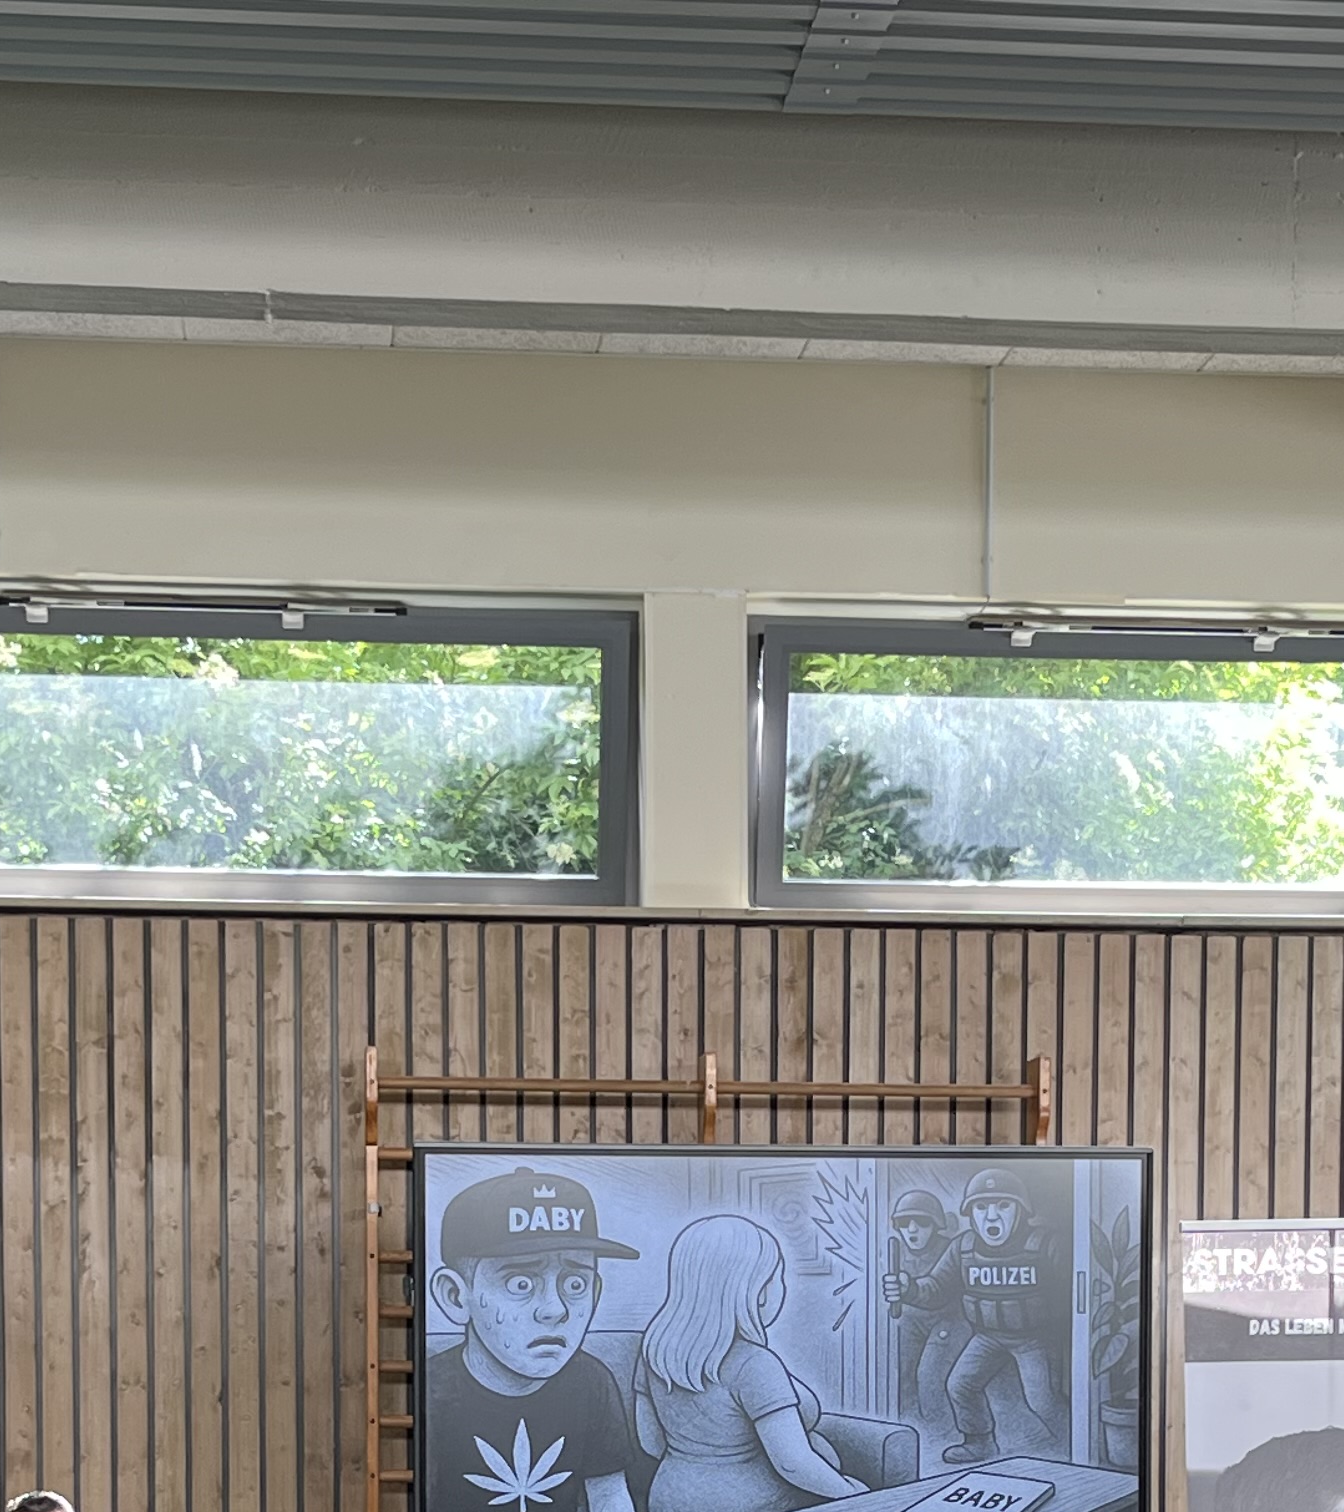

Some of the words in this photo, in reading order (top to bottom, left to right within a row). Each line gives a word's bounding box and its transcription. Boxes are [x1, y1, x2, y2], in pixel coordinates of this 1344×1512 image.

[509, 1206, 585, 1232] DABY
[969, 1266, 1037, 1285] POLIZEI
[1249, 1319, 1281, 1335] DAS
[1284, 1318, 1334, 1335] LEBEN
[942, 1487, 1022, 1512] BABY
